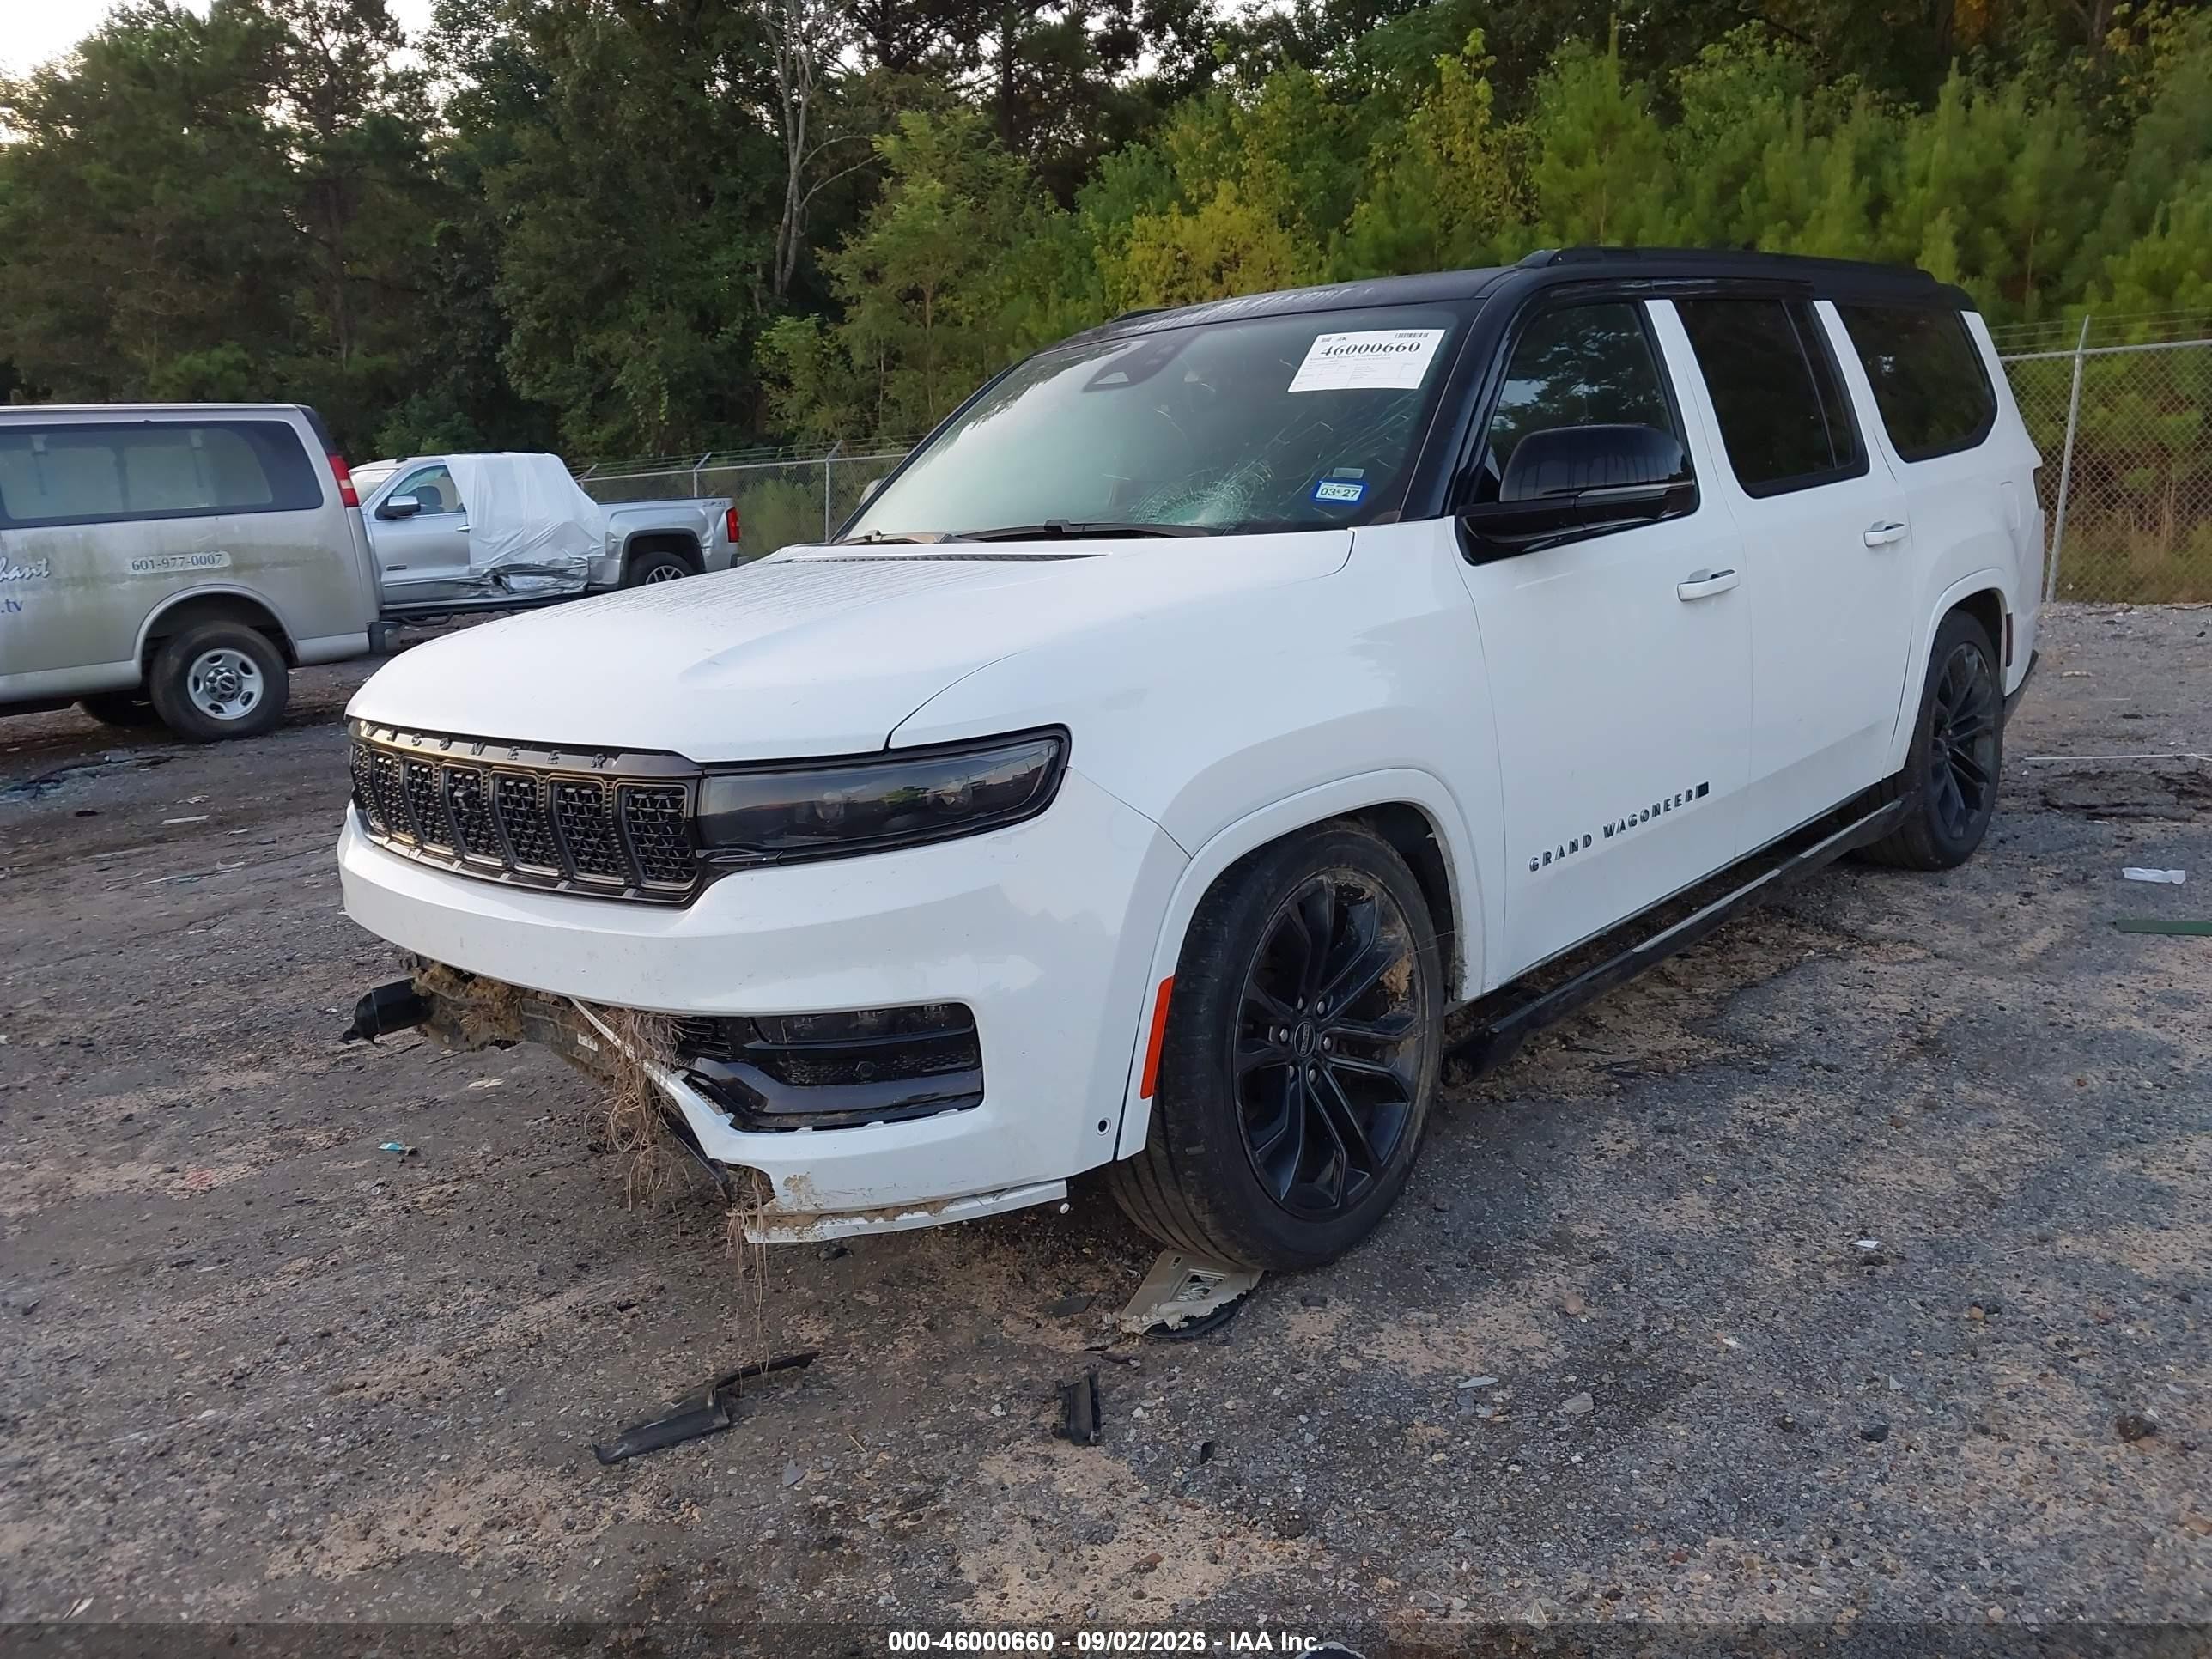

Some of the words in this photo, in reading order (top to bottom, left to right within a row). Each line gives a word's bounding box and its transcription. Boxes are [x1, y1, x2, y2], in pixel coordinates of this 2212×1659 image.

[1320, 341, 1421, 356] 46000660
[131, 553, 222, 571] 601-977-0007
[1528, 833, 1593, 872] GRAND
[1602, 788, 1694, 839] WAGONEER
